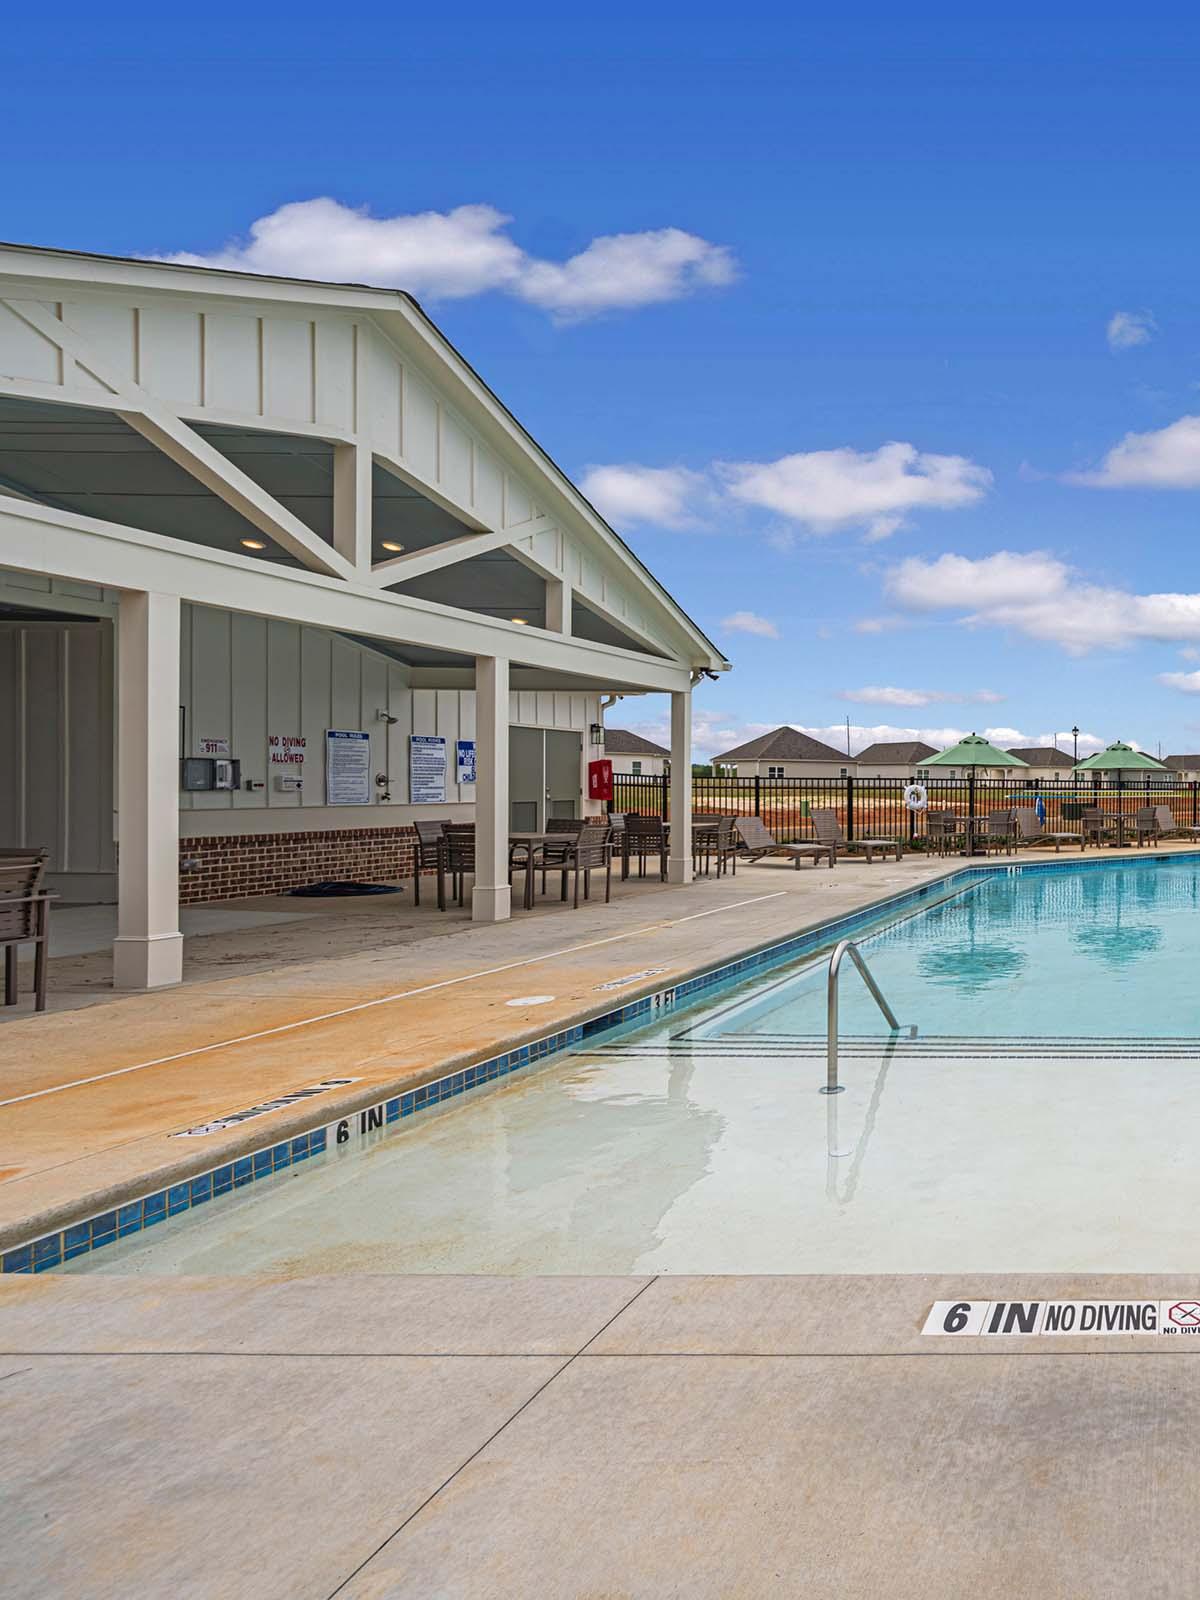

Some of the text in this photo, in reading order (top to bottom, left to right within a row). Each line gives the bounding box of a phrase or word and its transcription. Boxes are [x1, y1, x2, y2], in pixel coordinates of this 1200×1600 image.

[205, 743, 218, 753] 911
[269, 736, 306, 747] NO DIVING
[271, 753, 305, 763] ALLOWED
[655, 988, 675, 1008] 3 FT
[336, 1104, 383, 1144] 6 IN
[943, 1303, 1039, 1333] 6 IN
[1045, 1304, 1157, 1331] NO DIVING
[1163, 1327, 1177, 1335] NO
